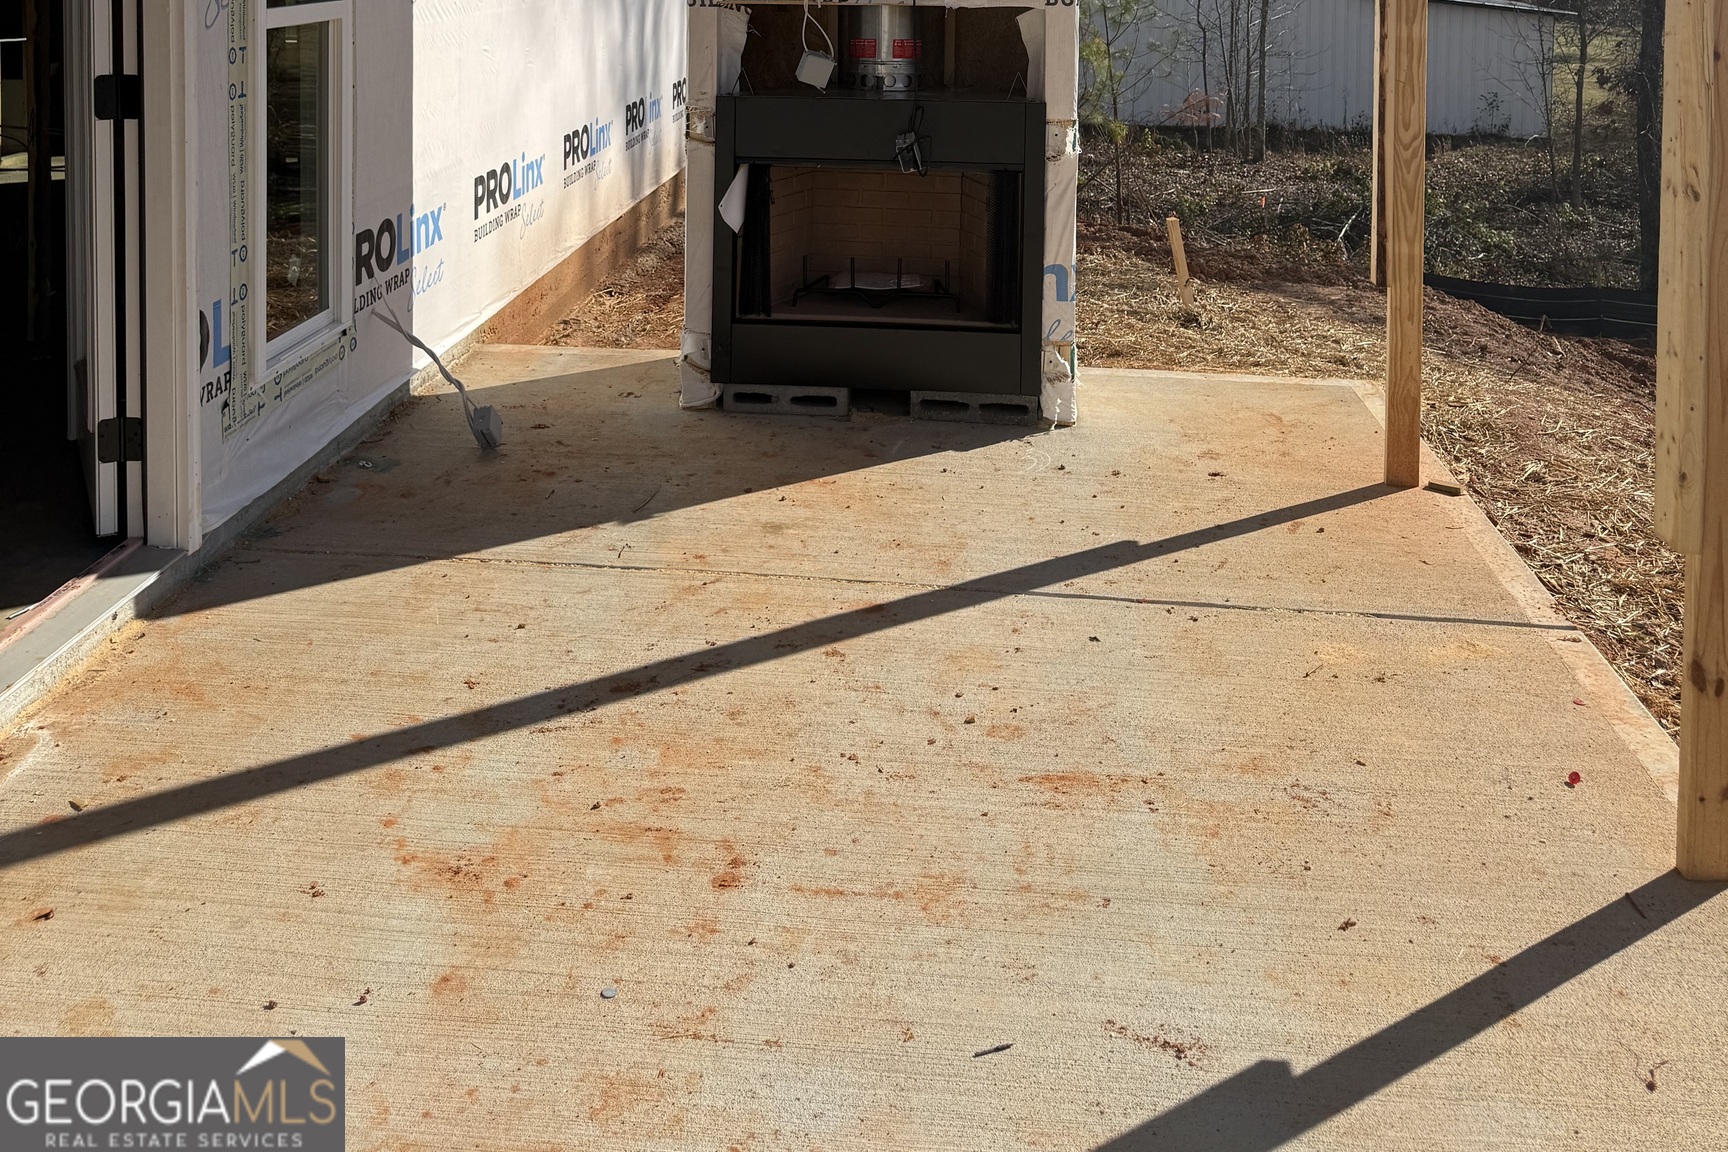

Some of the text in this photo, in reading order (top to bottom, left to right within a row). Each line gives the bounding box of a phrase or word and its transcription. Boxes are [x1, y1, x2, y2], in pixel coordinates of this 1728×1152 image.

[563, 166, 584, 189] BUILDING
[474, 204, 522, 243] BUILDING WRAP
[519, 199, 544, 240] Select
[385, 268, 410, 296] WRAP
